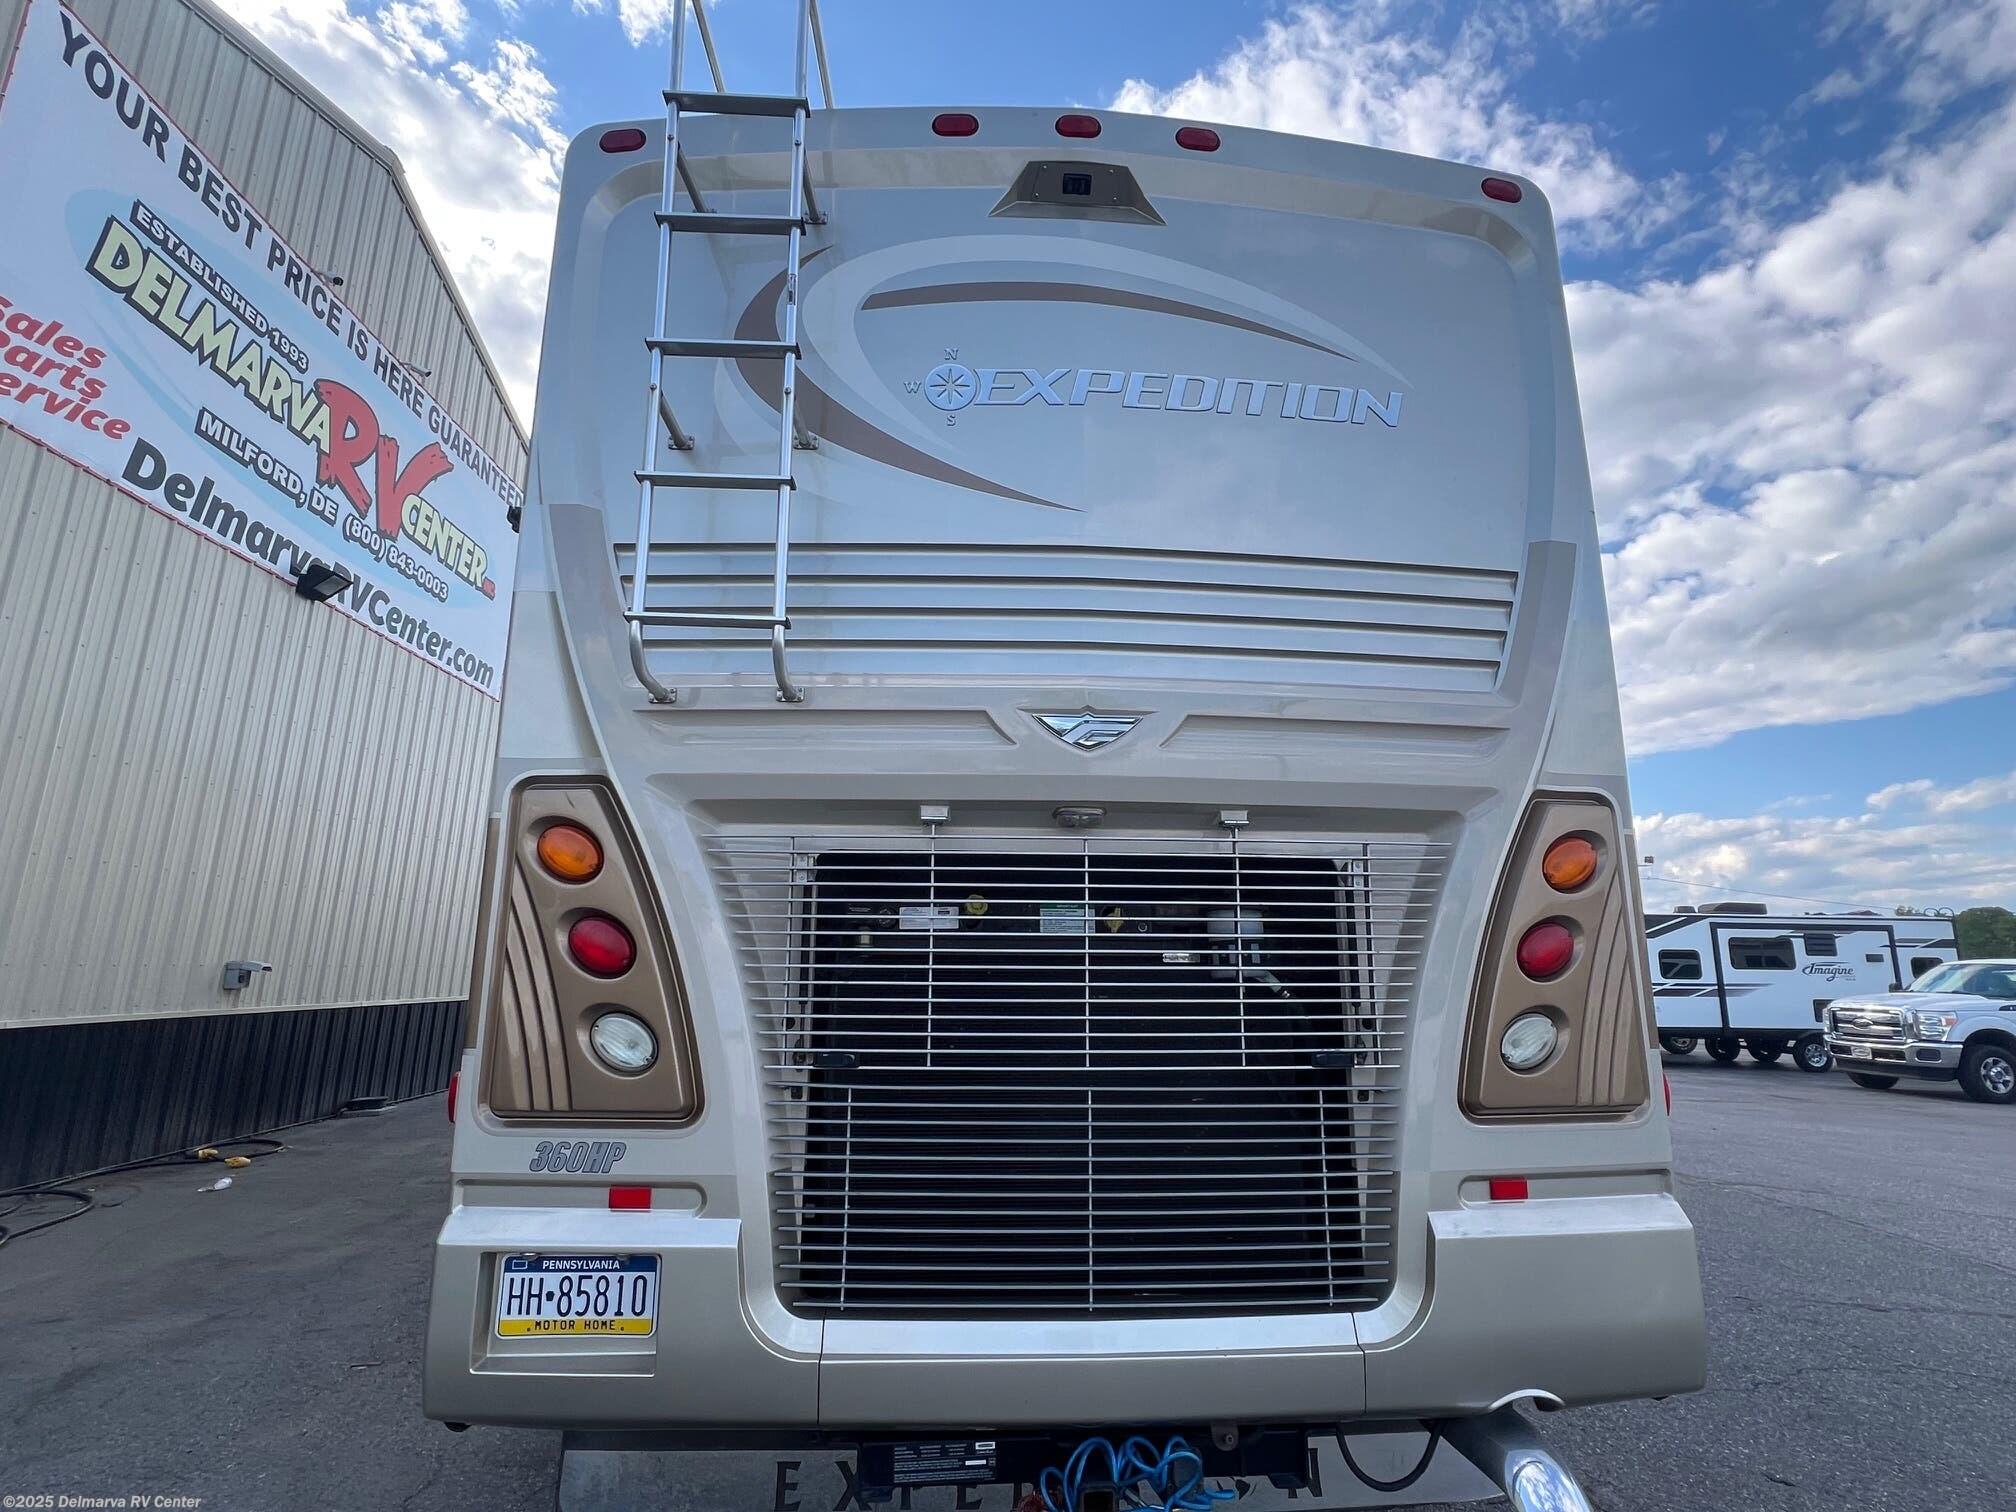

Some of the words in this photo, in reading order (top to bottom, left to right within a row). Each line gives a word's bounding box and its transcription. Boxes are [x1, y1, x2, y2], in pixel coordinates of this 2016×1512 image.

[58, 11, 170, 162] YOUR
[178, 142, 263, 250] BEST
[267, 238, 343, 334] PRICE
[347, 320, 370, 361] IS
[373, 357, 425, 420] HERE
[136, 205, 268, 334] ESTABLISHED
[271, 330, 308, 370] 1993
[944, 348, 958, 360] N
[0, 373, 131, 440] ervice
[90, 219, 330, 453] DELMARVA
[315, 378, 454, 541] RV
[400, 494, 489, 592] CENTER
[904, 381, 921, 394] W
[973, 367, 1403, 428] EXPEDITION
[946, 414, 956, 426] S
[200, 412, 304, 507] MILFORD,
[308, 490, 338, 526] DE
[122, 438, 494, 687] DelmarvVCenter.com
[343, 515, 387, 562] (800)
[387, 543, 449, 602] 843-0003
[1802, 962, 1855, 982] Imagine
[529, 1141, 627, 1174] 360HP
[542, 1259, 620, 1270] PENNSYLVANIA
[534, 1320, 576, 1331] MOTOR
[583, 1320, 617, 1331] HOME
